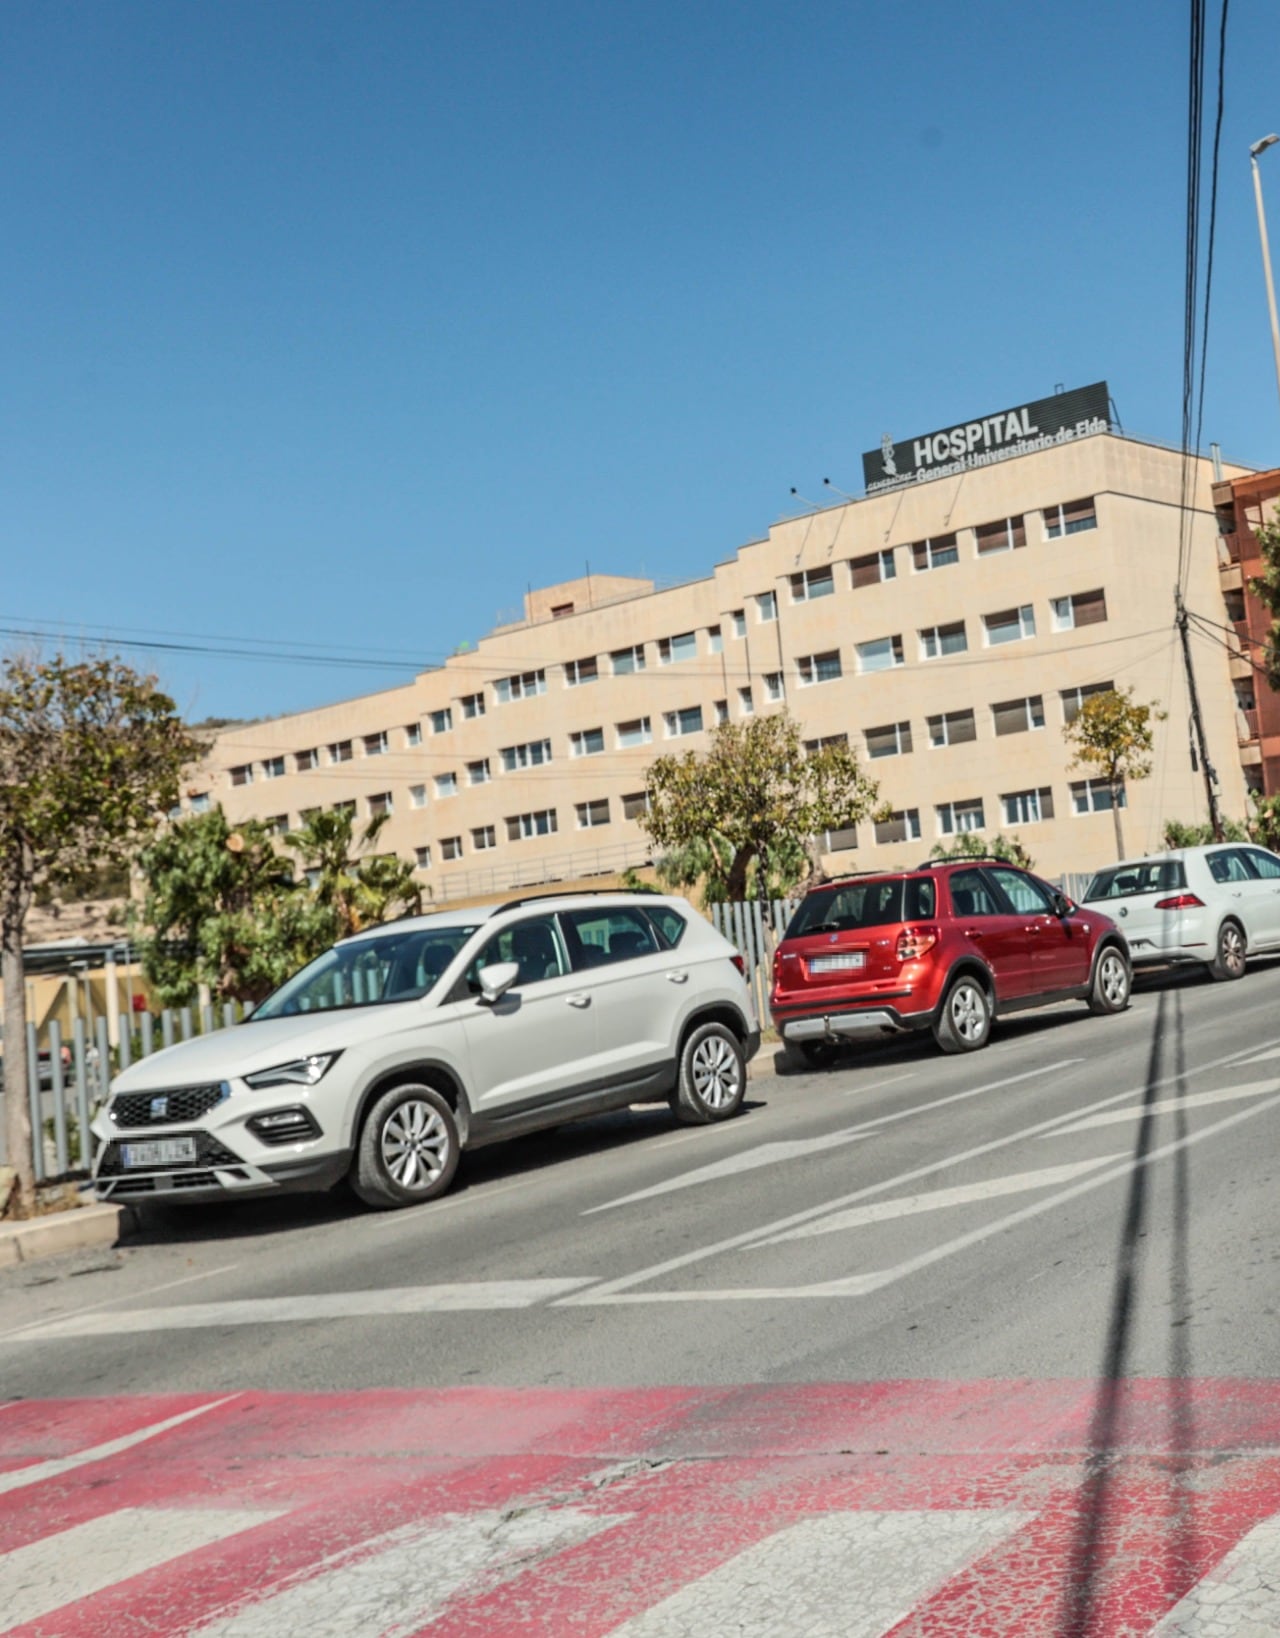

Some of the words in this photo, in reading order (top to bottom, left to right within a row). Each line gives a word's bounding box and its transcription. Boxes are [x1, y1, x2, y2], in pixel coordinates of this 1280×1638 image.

[913, 408, 1039, 467] HOSPITAL
[916, 455, 966, 482] General
[967, 432, 1053, 469] Universitario
[1055, 425, 1074, 443] de
[1075, 416, 1108, 439] Elda
